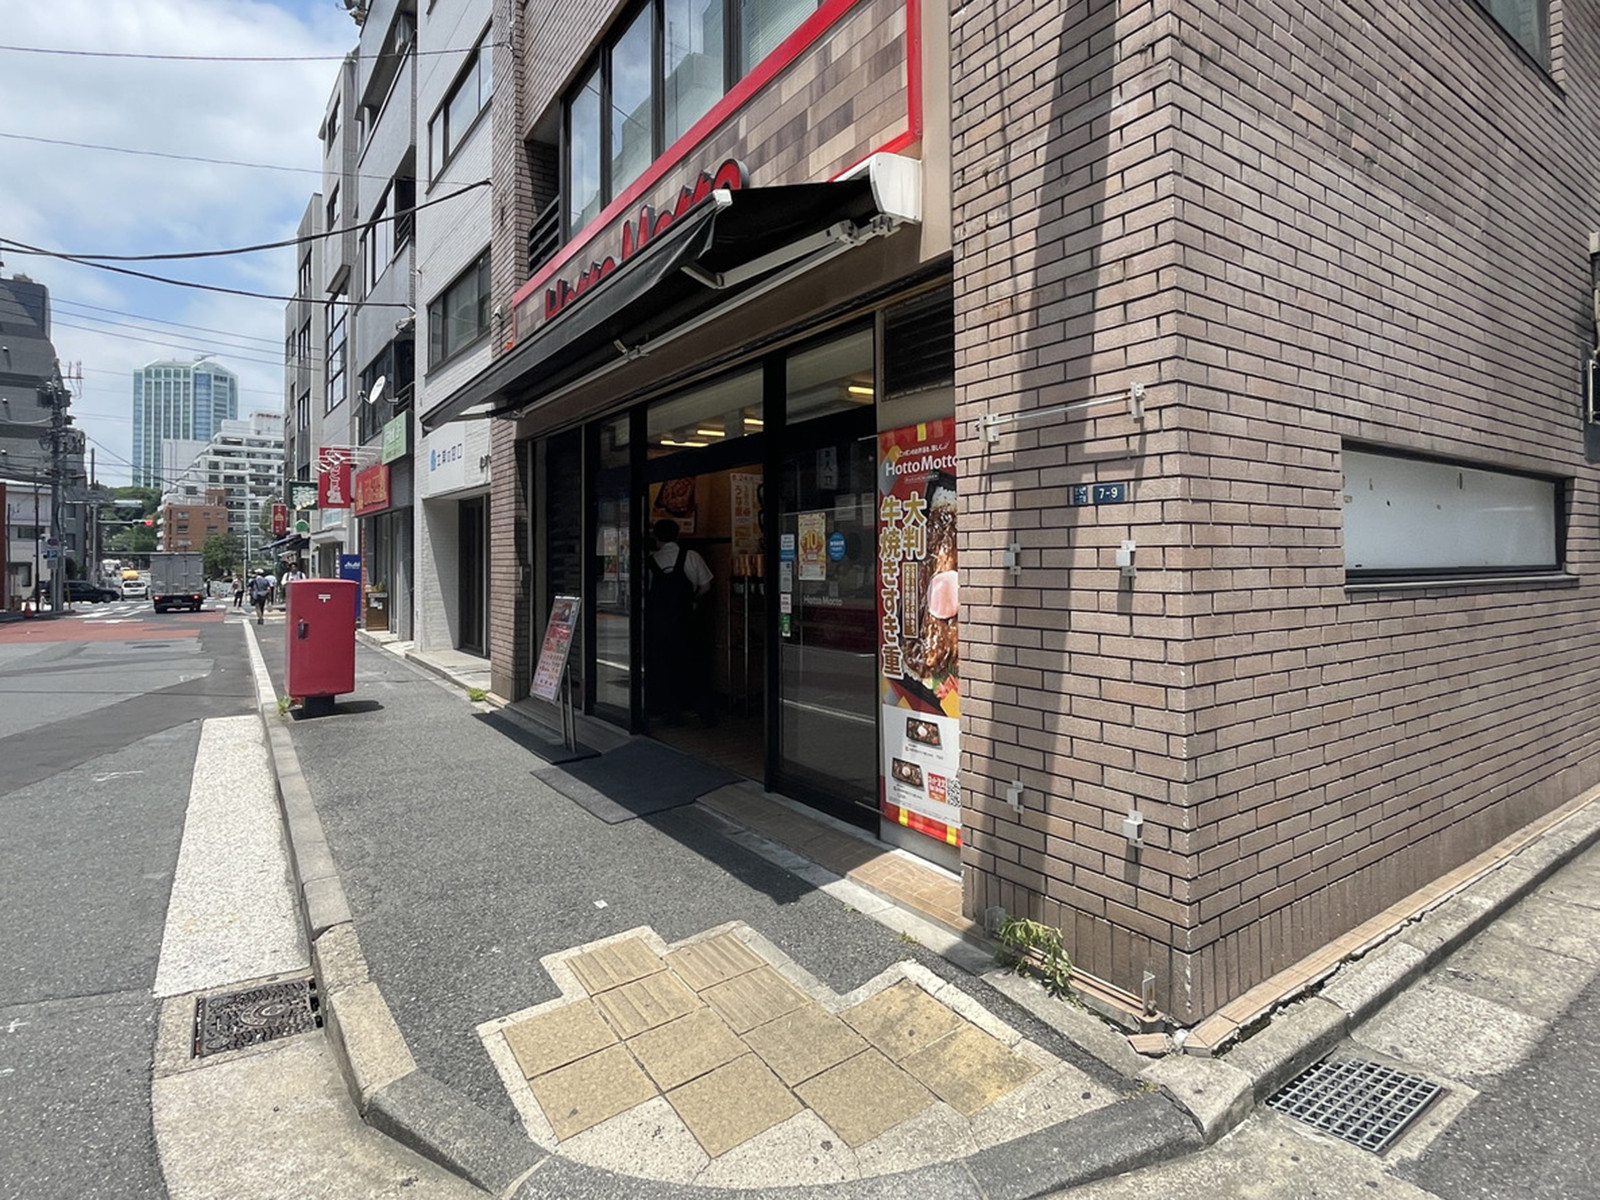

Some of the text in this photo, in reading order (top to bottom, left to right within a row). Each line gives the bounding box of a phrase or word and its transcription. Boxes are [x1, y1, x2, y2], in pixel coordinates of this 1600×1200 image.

[903, 491, 927, 560] 大判
[1098, 487, 1118, 499] 7-9
[879, 495, 904, 680] 牛焼きすき重
